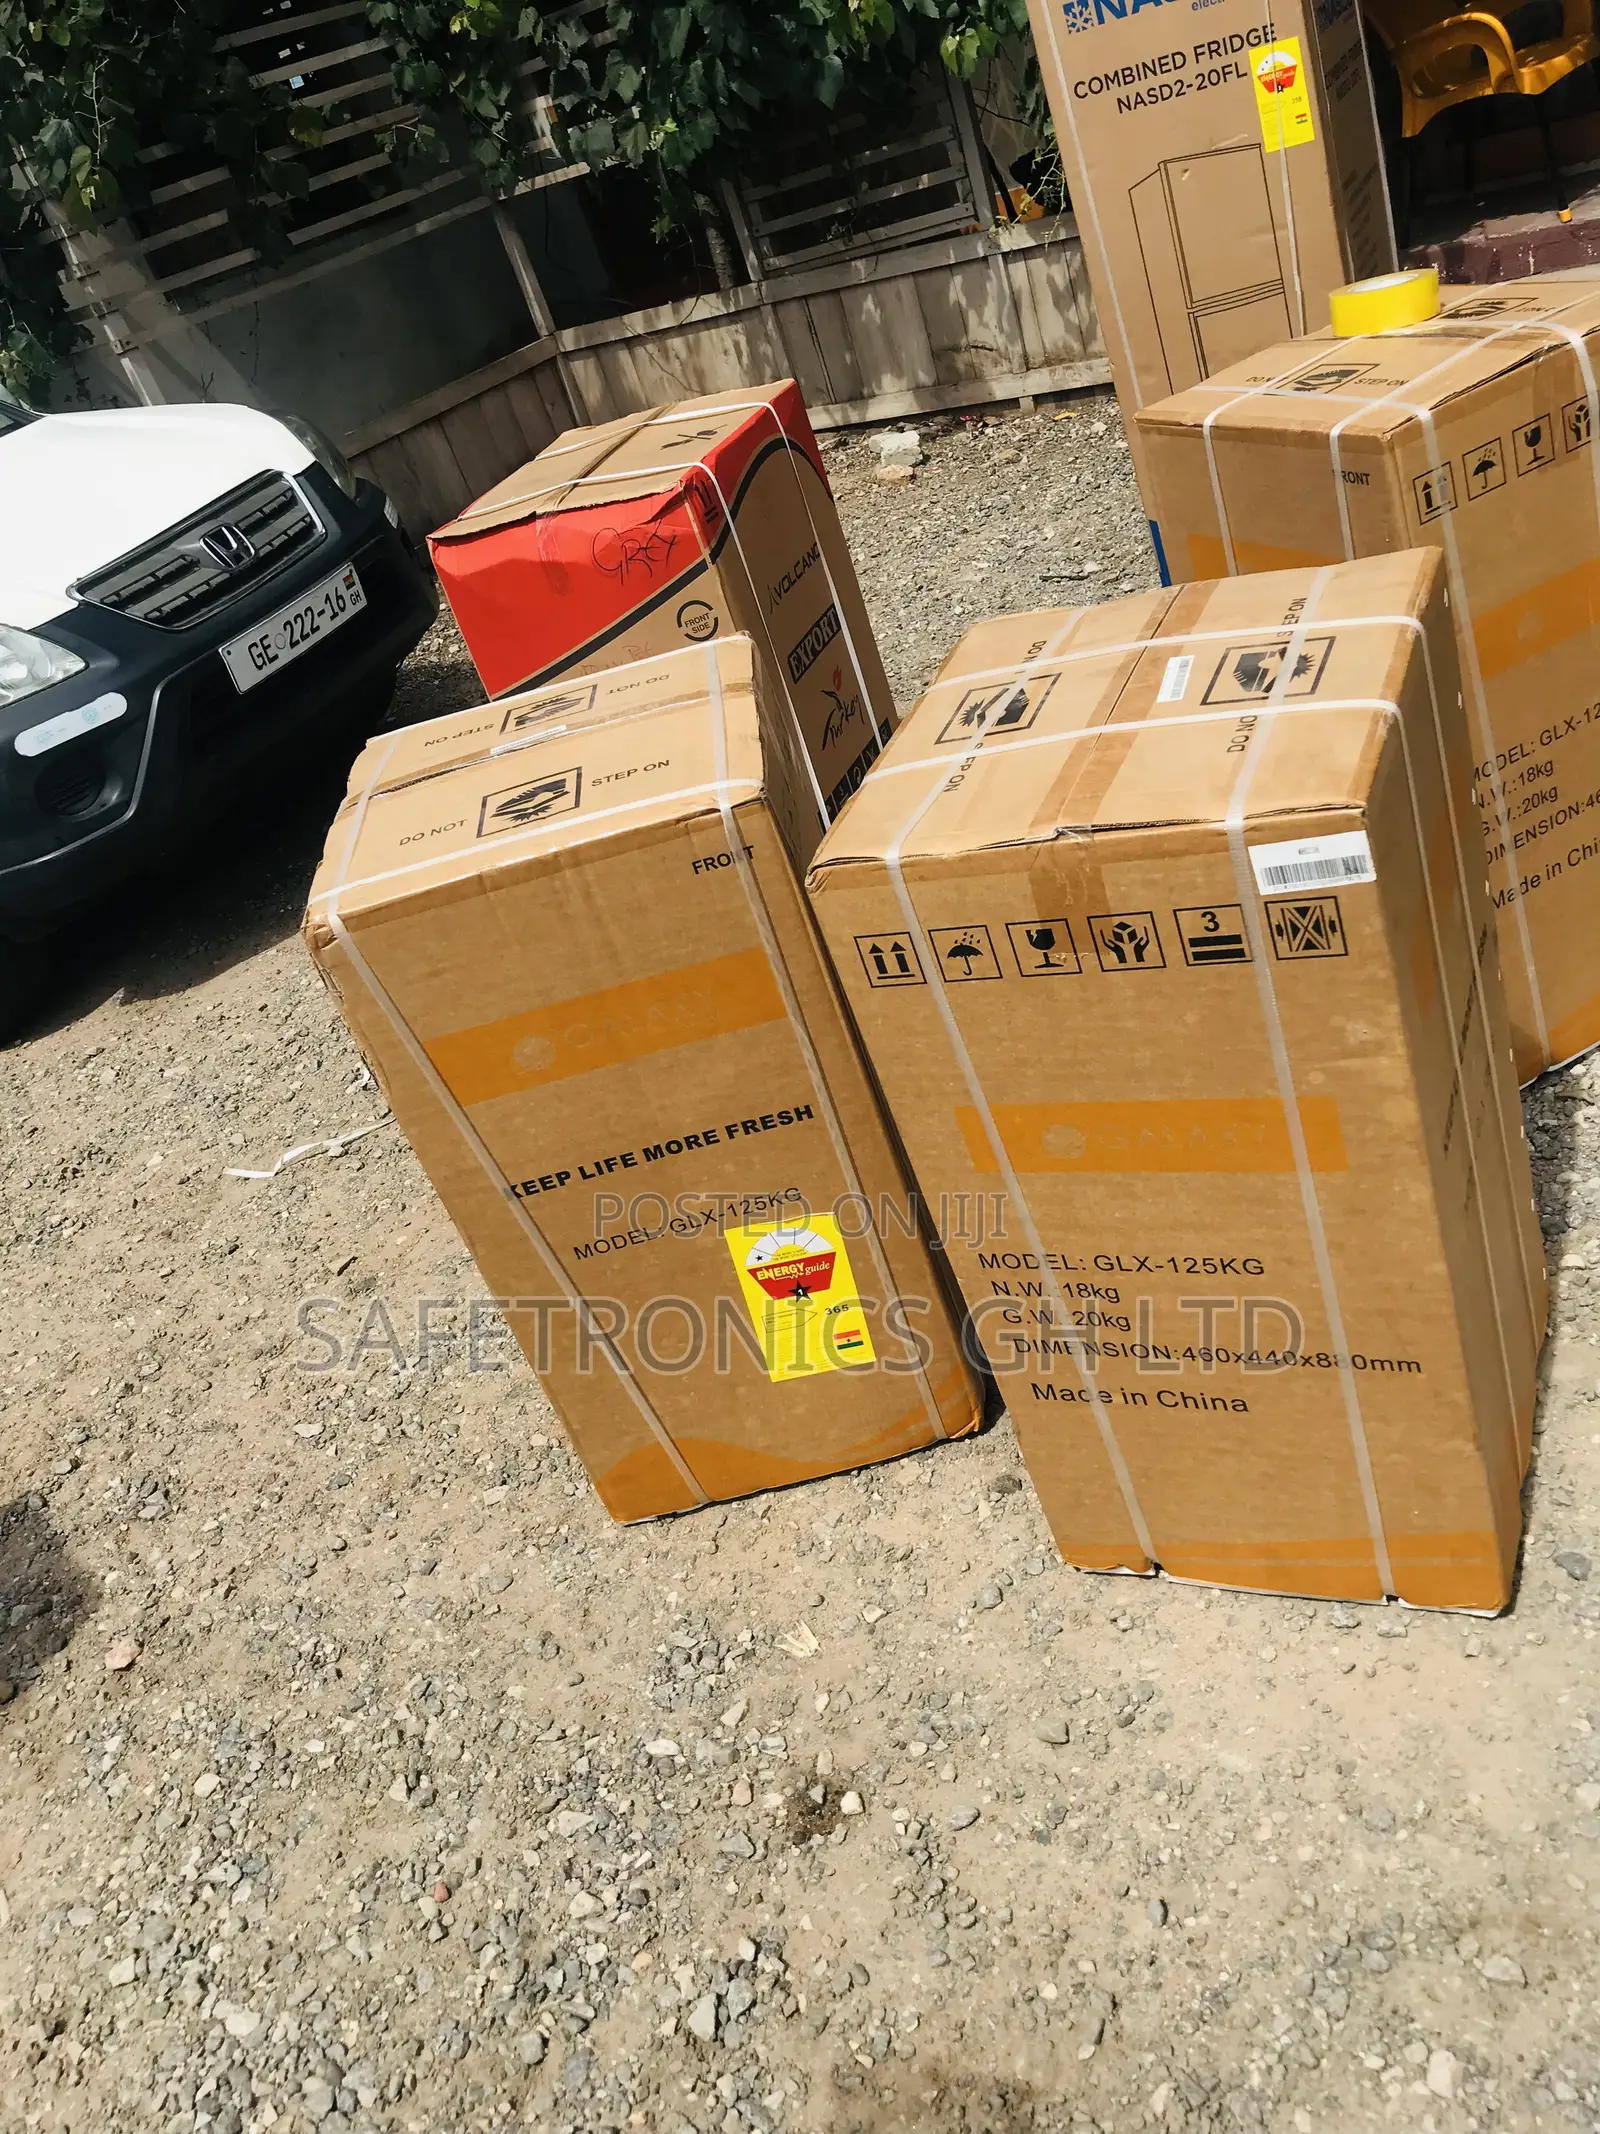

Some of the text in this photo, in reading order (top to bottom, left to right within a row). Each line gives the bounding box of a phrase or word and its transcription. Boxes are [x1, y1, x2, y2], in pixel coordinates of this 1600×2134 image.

[1073, 51, 1187, 100] COMBINED
[1193, 22, 1277, 65] FRIDGE
[1116, 62, 1248, 114] NASD2-20FL
[1332, 469, 1370, 486] RONT
[592, 518, 677, 586] GREY
[350, 590, 362, 606] GH
[247, 587, 347, 671] GE 222-16
[684, 612, 710, 628] FRONT
[691, 621, 711, 634] SIDE
[1276, 613, 1300, 638] SEP
[790, 606, 841, 678] EXPORT
[1235, 714, 1258, 732] NO
[399, 759, 671, 846] DO NOT STEP ON
[1545, 862, 1563, 880] in
[1567, 836, 1600, 867] Chi
[1201, 911, 1220, 932] 3
[505, 1104, 815, 1200] KEEP LIFE MORE FRESH
[669, 1187, 803, 1231] GLX-125KG
[756, 1261, 830, 1281] ENERGY guide
[978, 1253, 1265, 1276] MODEL: GLX-125KG
[991, 1281, 1120, 1303] N.W.18kg
[825, 1304, 849, 1316] 365
[1002, 1308, 1131, 1333] G.W.20kg
[1030, 1382, 1249, 1413] Made in China
